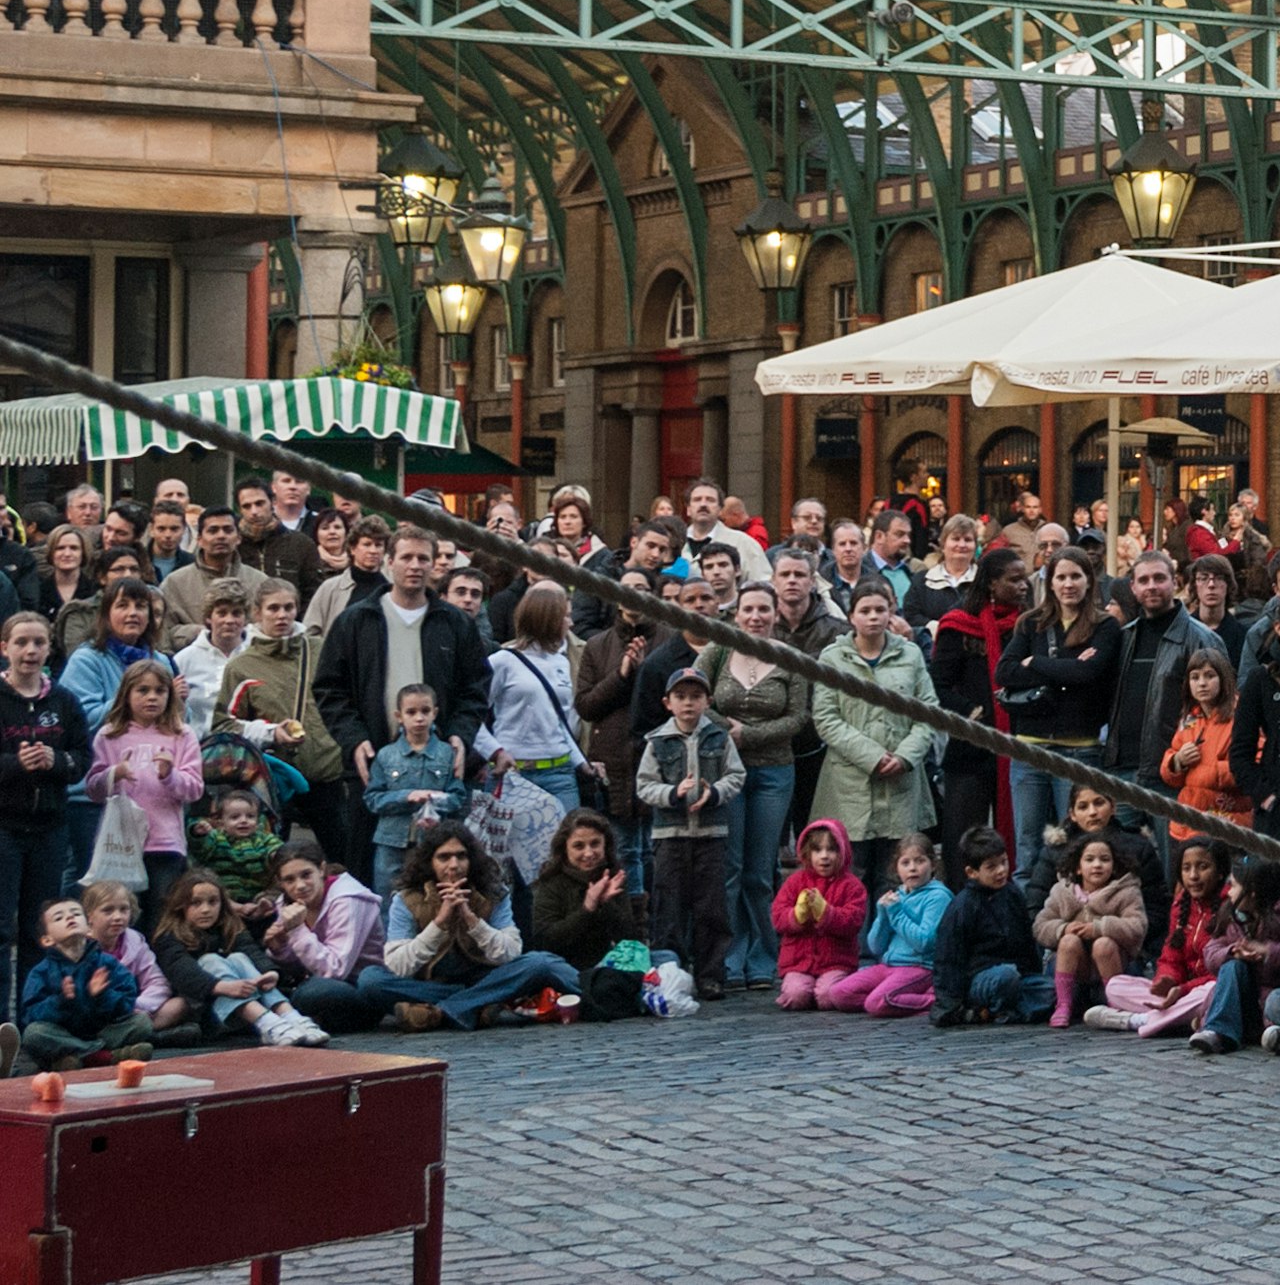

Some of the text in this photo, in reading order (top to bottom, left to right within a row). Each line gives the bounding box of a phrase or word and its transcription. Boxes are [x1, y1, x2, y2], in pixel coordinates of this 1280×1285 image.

[840, 372, 893, 385] FUEL
[1073, 366, 1098, 385] vino
[1099, 370, 1168, 385] FUEL
[1181, 365, 1210, 386] café
